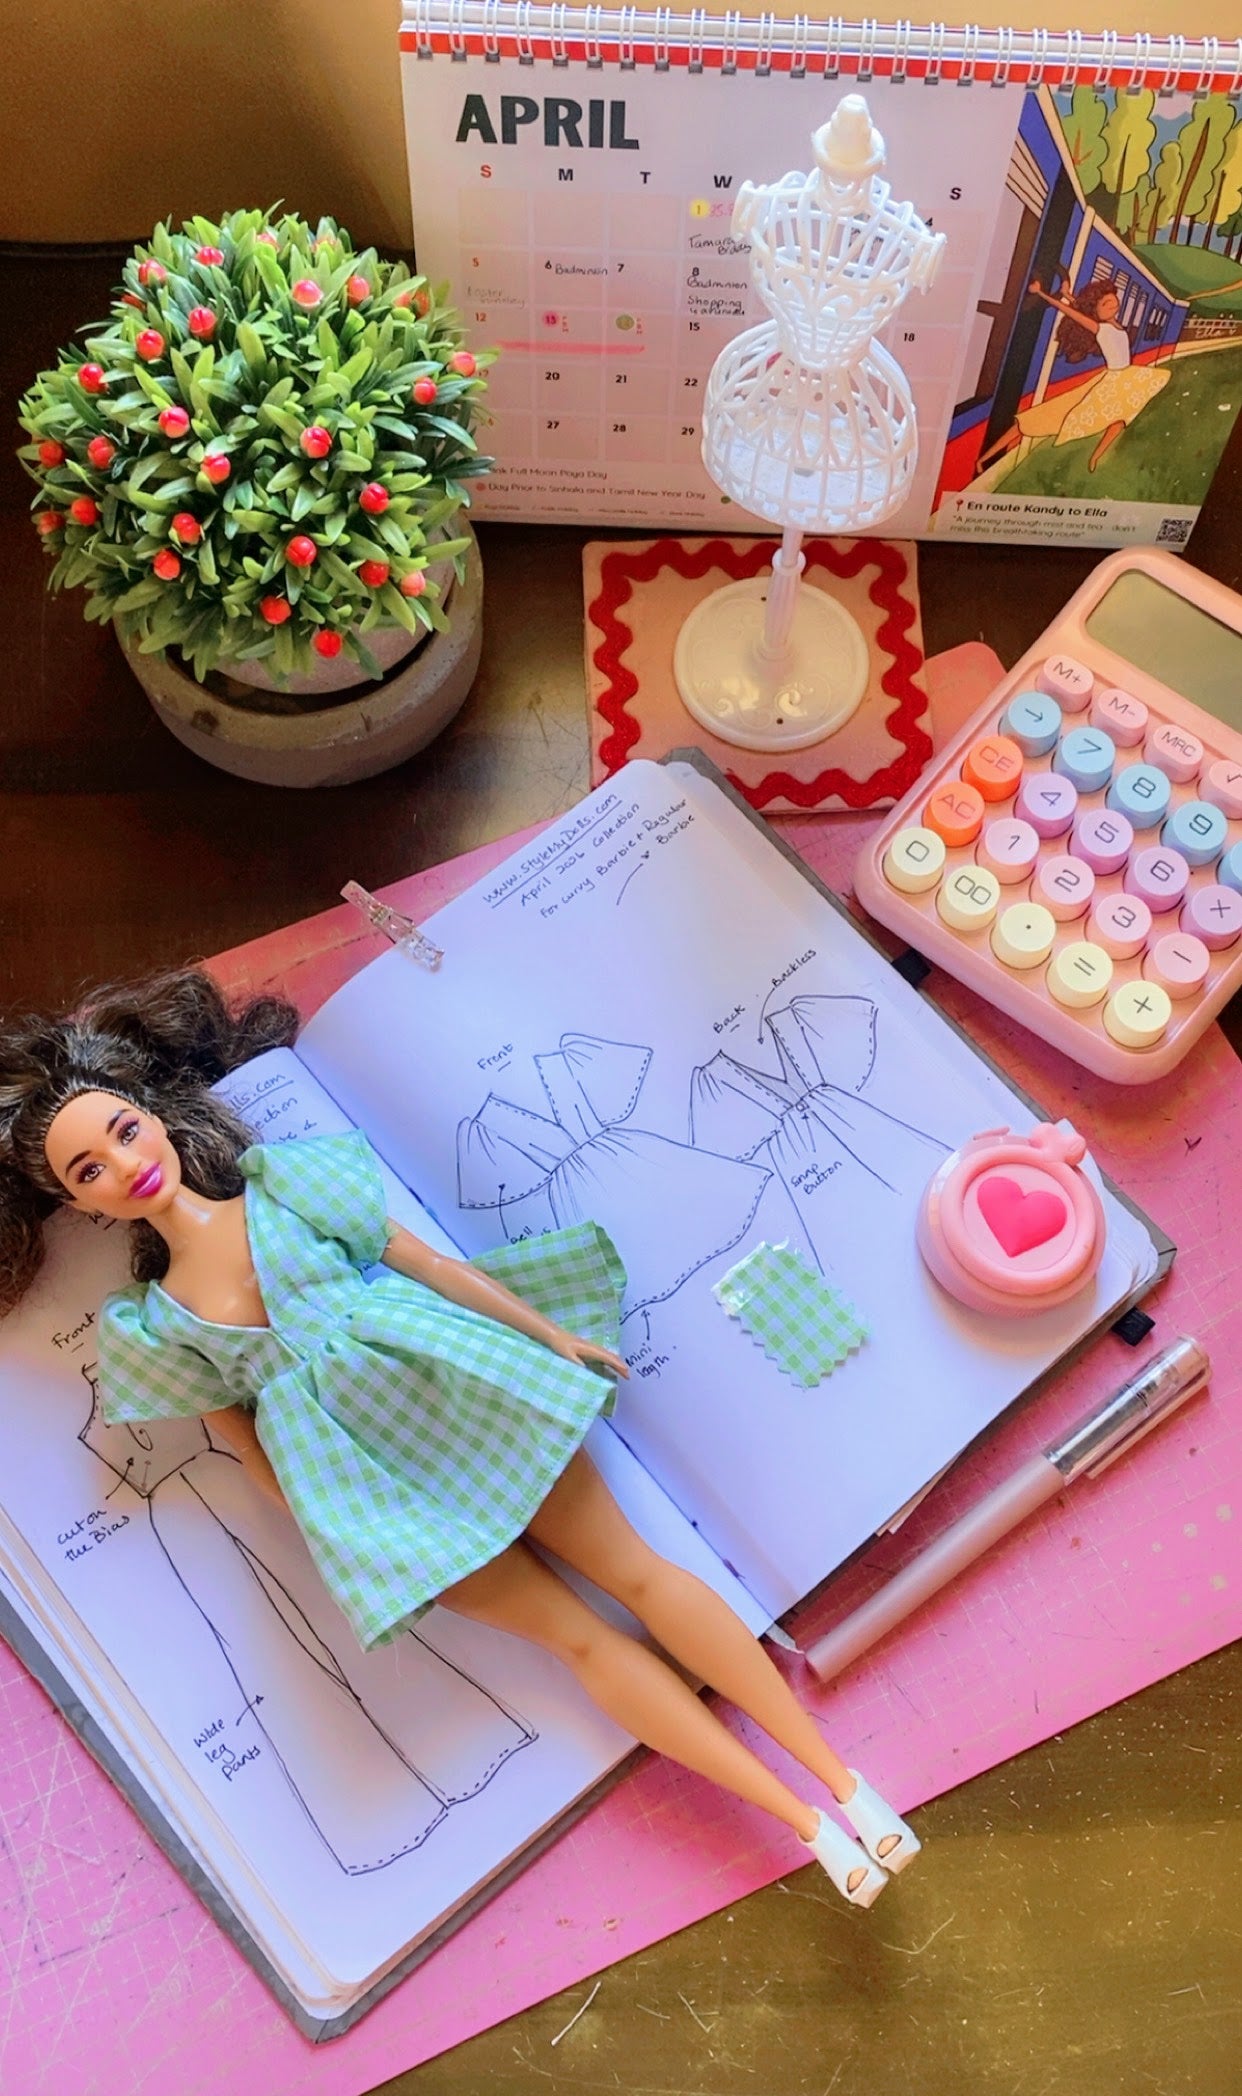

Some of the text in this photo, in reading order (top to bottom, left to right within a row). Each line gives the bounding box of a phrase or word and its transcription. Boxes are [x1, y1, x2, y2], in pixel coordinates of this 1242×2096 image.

[455, 93, 640, 150] APRIL
[480, 164, 962, 200] S M T W S
[472, 257, 553, 270] 5 6
[617, 263, 700, 277] 7 8
[475, 312, 487, 322] 12
[689, 321, 701, 332] 15
[903, 332, 916, 342] 18
[545, 371, 560, 381] 20
[615, 375, 628, 384] 21
[684, 378, 698, 387] 22
[547, 420, 560, 430] 27
[613, 423, 627, 433] 28
[681, 426, 695, 436] 29
[510, 468, 528, 476] Full
[529, 469, 558, 477] Moon
[587, 471, 608, 481] Day
[488, 482, 510, 493] Day
[536, 484, 546, 493] to
[685, 490, 706, 500] Day
[963, 516, 1002, 527] journey
[1003, 516, 1042, 528] through
[966, 501, 1108, 518] En route Kandy to Ella
[1053, 661, 1082, 685] M+
[1161, 731, 1197, 758] MRC
[979, 738, 1157, 799] CE 7 8
[655, 813, 696, 845] Barbie
[940, 791, 1213, 844] AC 4 5 9
[521, 876, 552, 907] April
[592, 803, 640, 848] Collection
[595, 840, 637, 876] Barbie
[905, 835, 1175, 893] 0 1 2 6
[954, 874, 992, 906] 00
[1111, 905, 1137, 929] 3
[712, 949, 817, 1034] Back Backless
[476, 1043, 514, 1070] Front
[802, 1160, 843, 1195] Button
[51, 1311, 96, 1349] Front
[88, 1515, 131, 1544] Bias
[204, 1743, 236, 1766] leg
